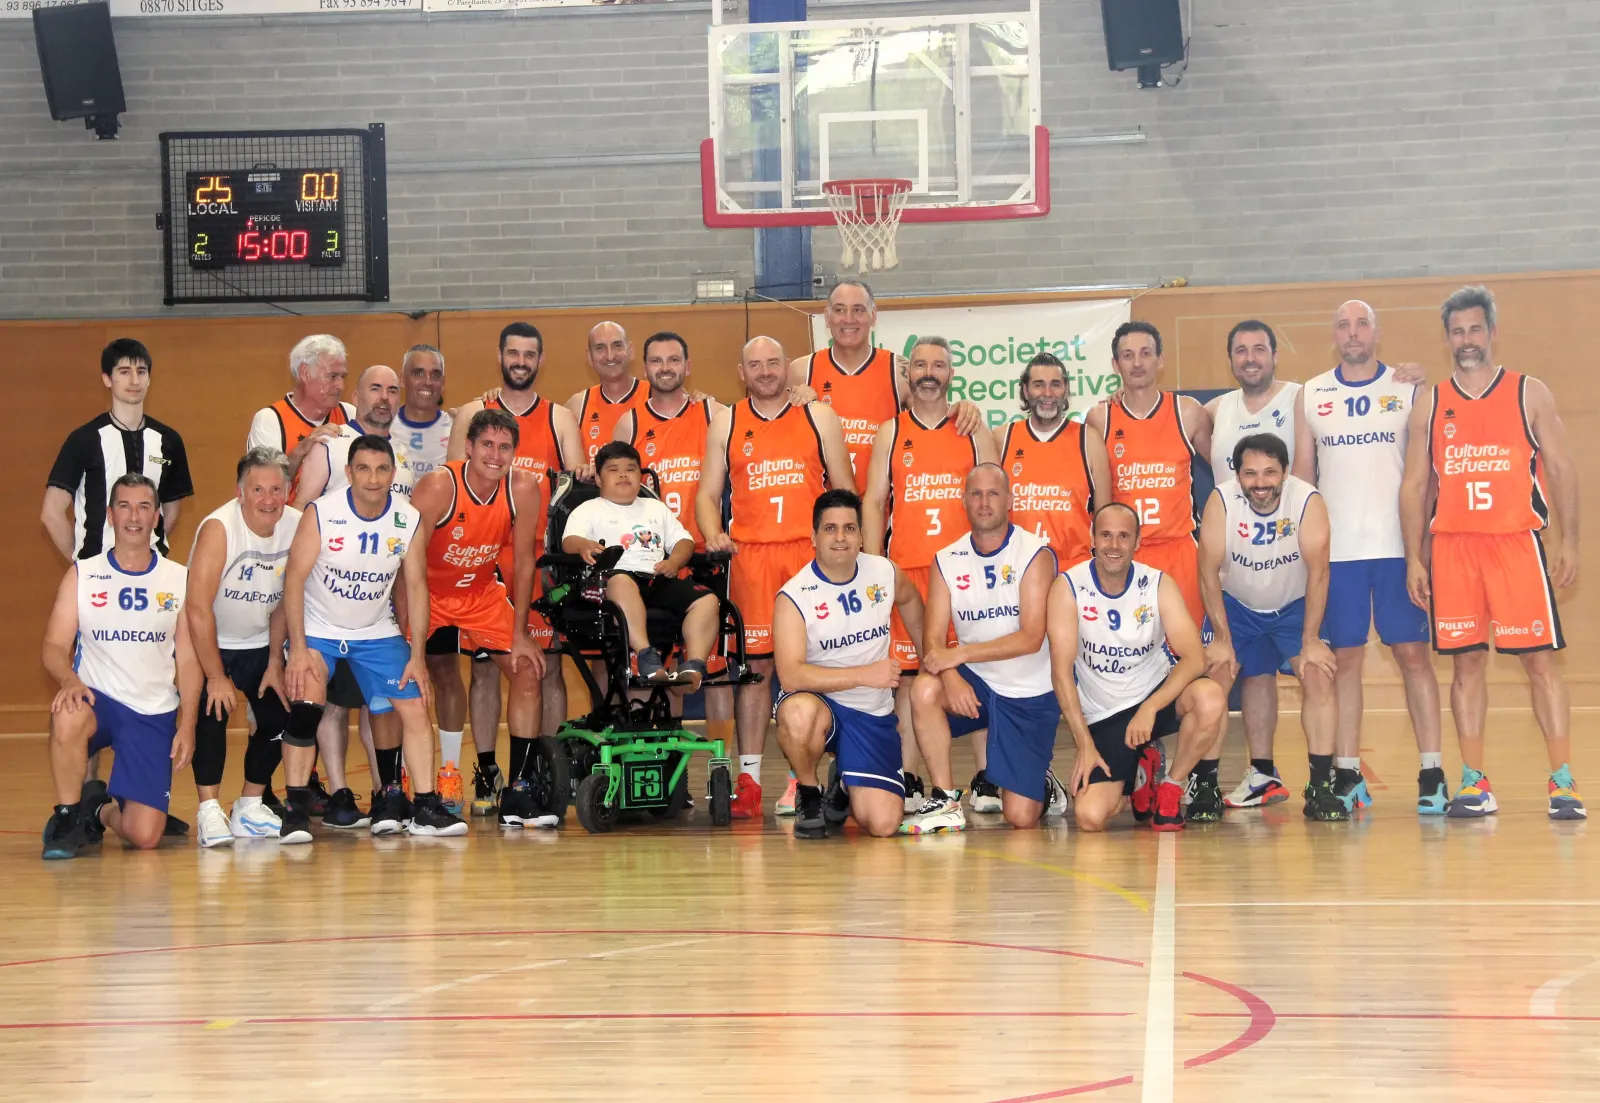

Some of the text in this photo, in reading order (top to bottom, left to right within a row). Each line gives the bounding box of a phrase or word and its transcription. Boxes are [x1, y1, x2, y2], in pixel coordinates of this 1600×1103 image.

[6, 1, 19, 11] 93
[140, 0, 224, 13] 08870 SITGES
[196, 176, 232, 203] 25
[302, 172, 338, 200] 00
[188, 203, 238, 216] LOCAL
[295, 200, 339, 213] VISITANT
[194, 233, 209, 255] 2
[237, 231, 308, 260] 15:00
[326, 230, 338, 252] 3
[947, 334, 1087, 367] Societat
[946, 368, 1122, 402] Recrtiva
[1343, 395, 1371, 417] 10
[1320, 431, 1396, 448] VILADECANS
[1444, 444, 1510, 459] Cultura del
[746, 459, 805, 475] Cultura del
[1116, 462, 1176, 477] Cultura del
[1444, 458, 1511, 475] Esfuerzo
[747, 472, 805, 491] Esfuerzo
[905, 472, 962, 487] Cultura del
[1011, 482, 1072, 498] Cultura del
[1116, 476, 1176, 492] Esfuerzo
[1011, 497, 1072, 512] Esfuerzo
[1465, 481, 1493, 511] 15
[769, 495, 784, 524] 7
[1134, 498, 1161, 525] 12
[925, 508, 942, 536] 3
[357, 531, 379, 555] 11
[1251, 521, 1277, 546] 25
[455, 573, 476, 588] 2
[983, 565, 997, 590] 5
[118, 587, 149, 612] 65
[836, 589, 863, 616] 16
[1106, 609, 1121, 631] 9
[1438, 620, 1476, 631] PULEVA
[1494, 624, 1529, 636] Midea
[91, 629, 167, 643] VILADECANS
[530, 627, 554, 637] Mide
[744, 629, 769, 638] ULEVA
[819, 623, 890, 651] VILADECANS
[1081, 637, 1155, 658] VILADECANS
[634, 769, 660, 798] F3
